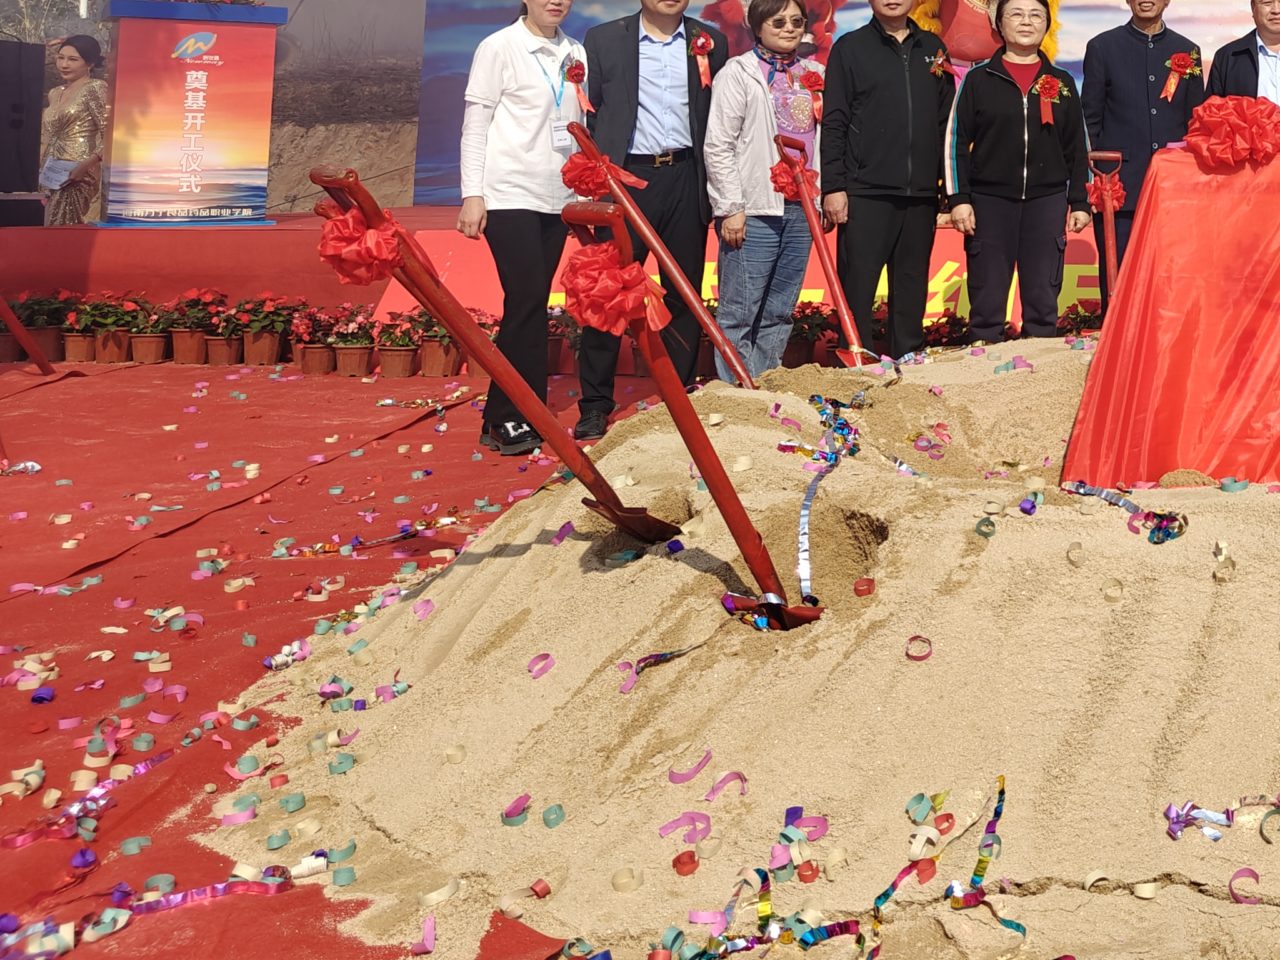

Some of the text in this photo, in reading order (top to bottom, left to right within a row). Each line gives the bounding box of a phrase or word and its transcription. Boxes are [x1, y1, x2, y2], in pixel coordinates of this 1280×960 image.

[178, 70, 209, 193] 奠基开工仪式
